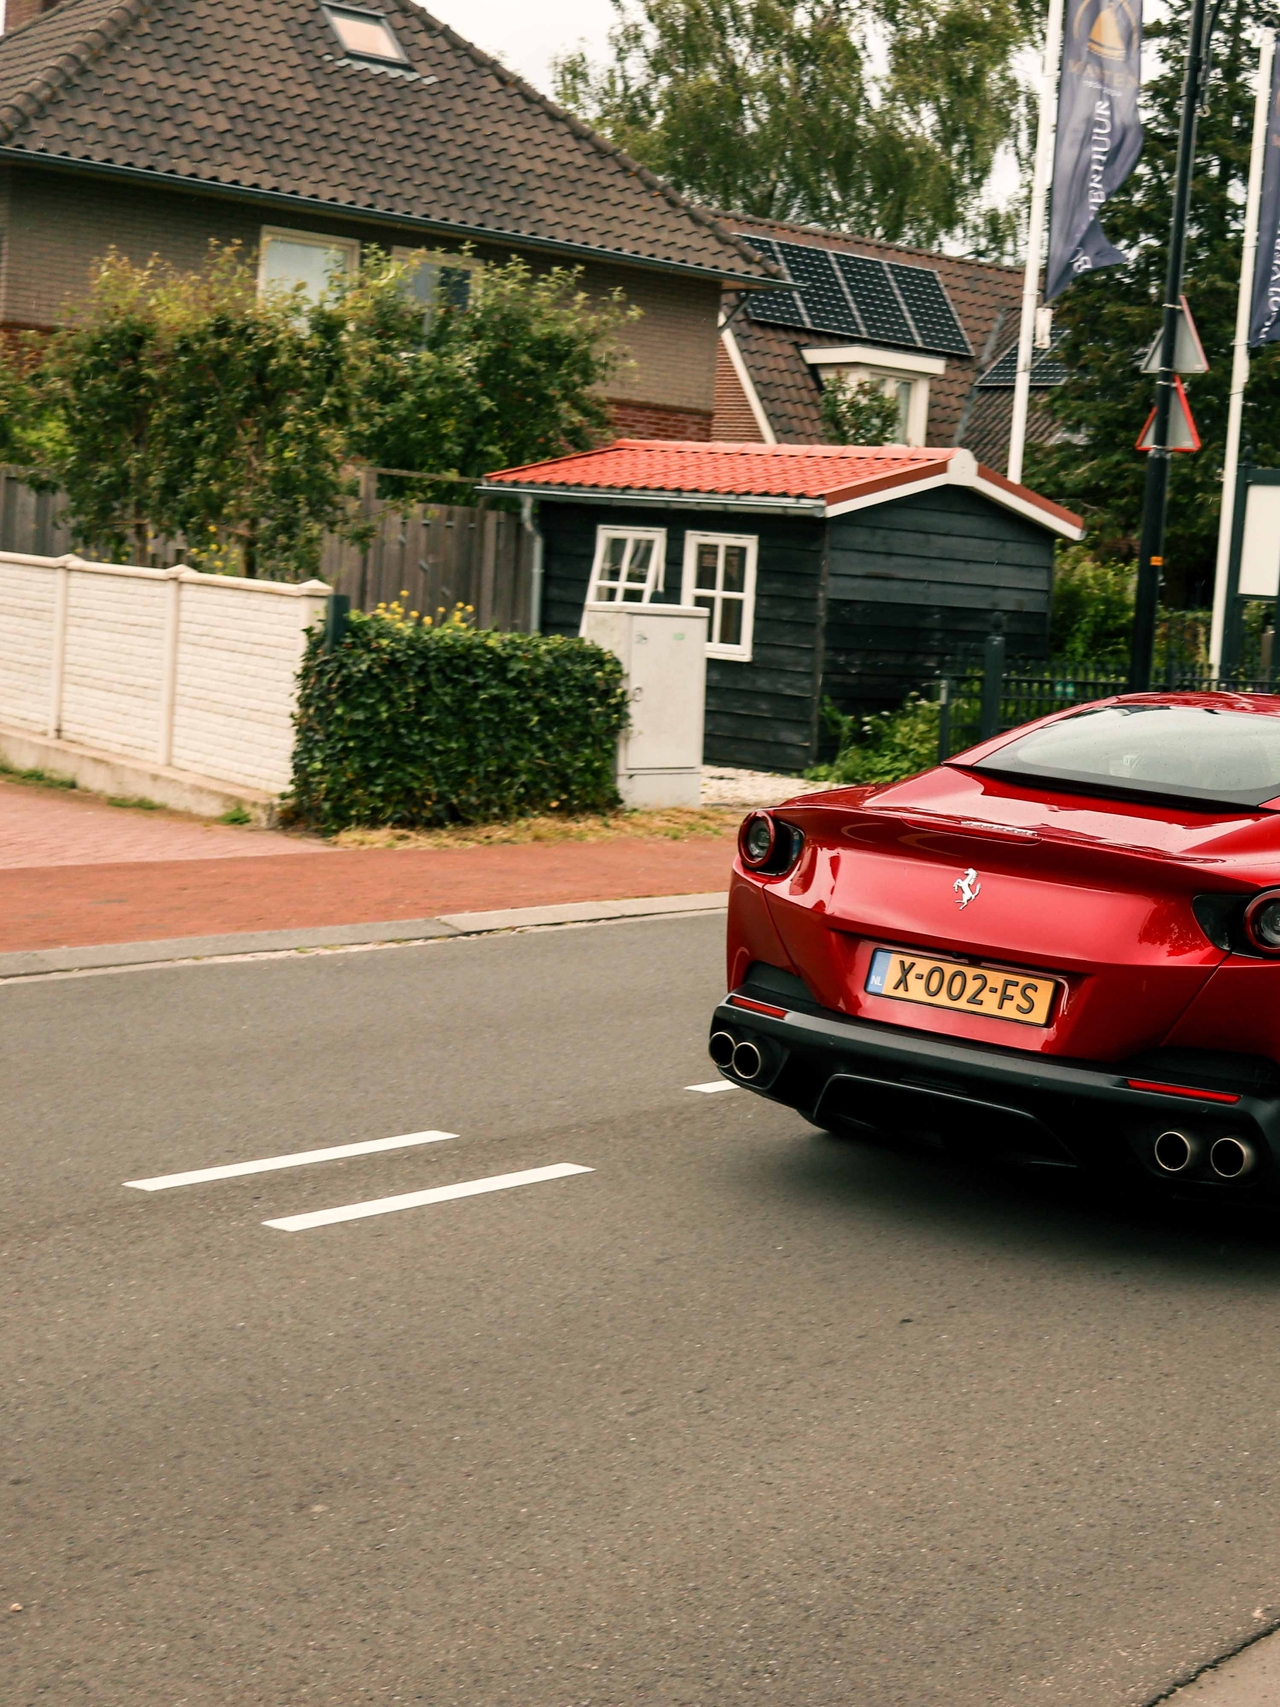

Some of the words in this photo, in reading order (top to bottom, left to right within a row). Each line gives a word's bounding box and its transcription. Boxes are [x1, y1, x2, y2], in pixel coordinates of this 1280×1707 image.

[1069, 100, 1112, 273] BOERHUUR
[870, 975, 883, 986] NL
[893, 960, 1038, 1014] X-002-FS
